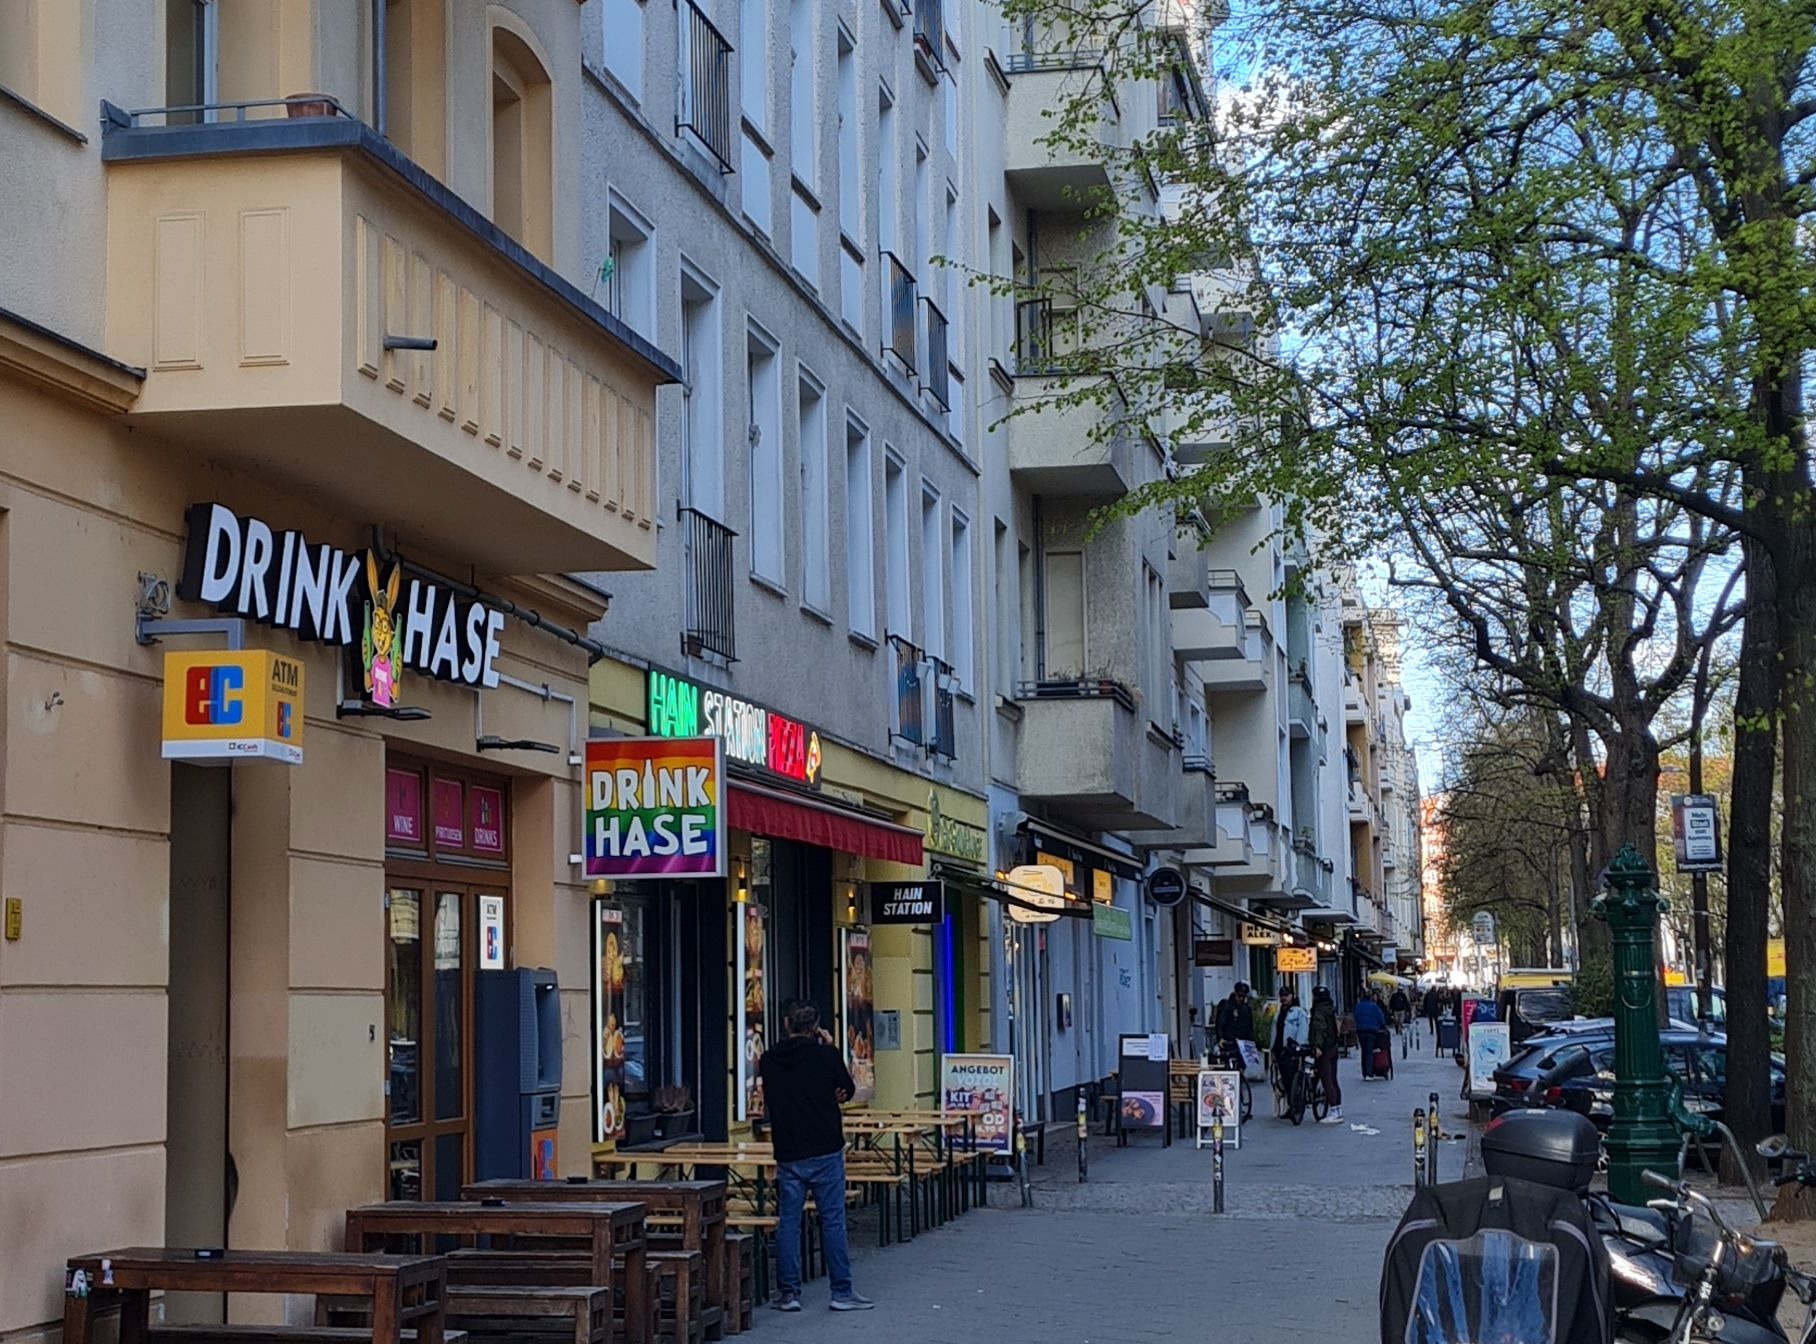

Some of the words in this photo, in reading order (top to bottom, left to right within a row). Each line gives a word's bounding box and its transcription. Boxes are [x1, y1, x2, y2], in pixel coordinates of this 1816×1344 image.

[201, 503, 361, 646] DRINK
[403, 578, 506, 689] HASE
[271, 658, 299, 687] ATM
[651, 670, 697, 737] HAIN
[768, 712, 806, 782] PIZZA
[591, 758, 711, 812] DRINK
[393, 815, 413, 835] WINE
[595, 813, 708, 857] HASE
[474, 827, 498, 846] DRINKS
[893, 887, 923, 901] HAIN
[883, 901, 933, 916] STATION
[951, 1064, 1004, 1075] ANGEBOT
[950, 1091, 970, 1103] KIT
